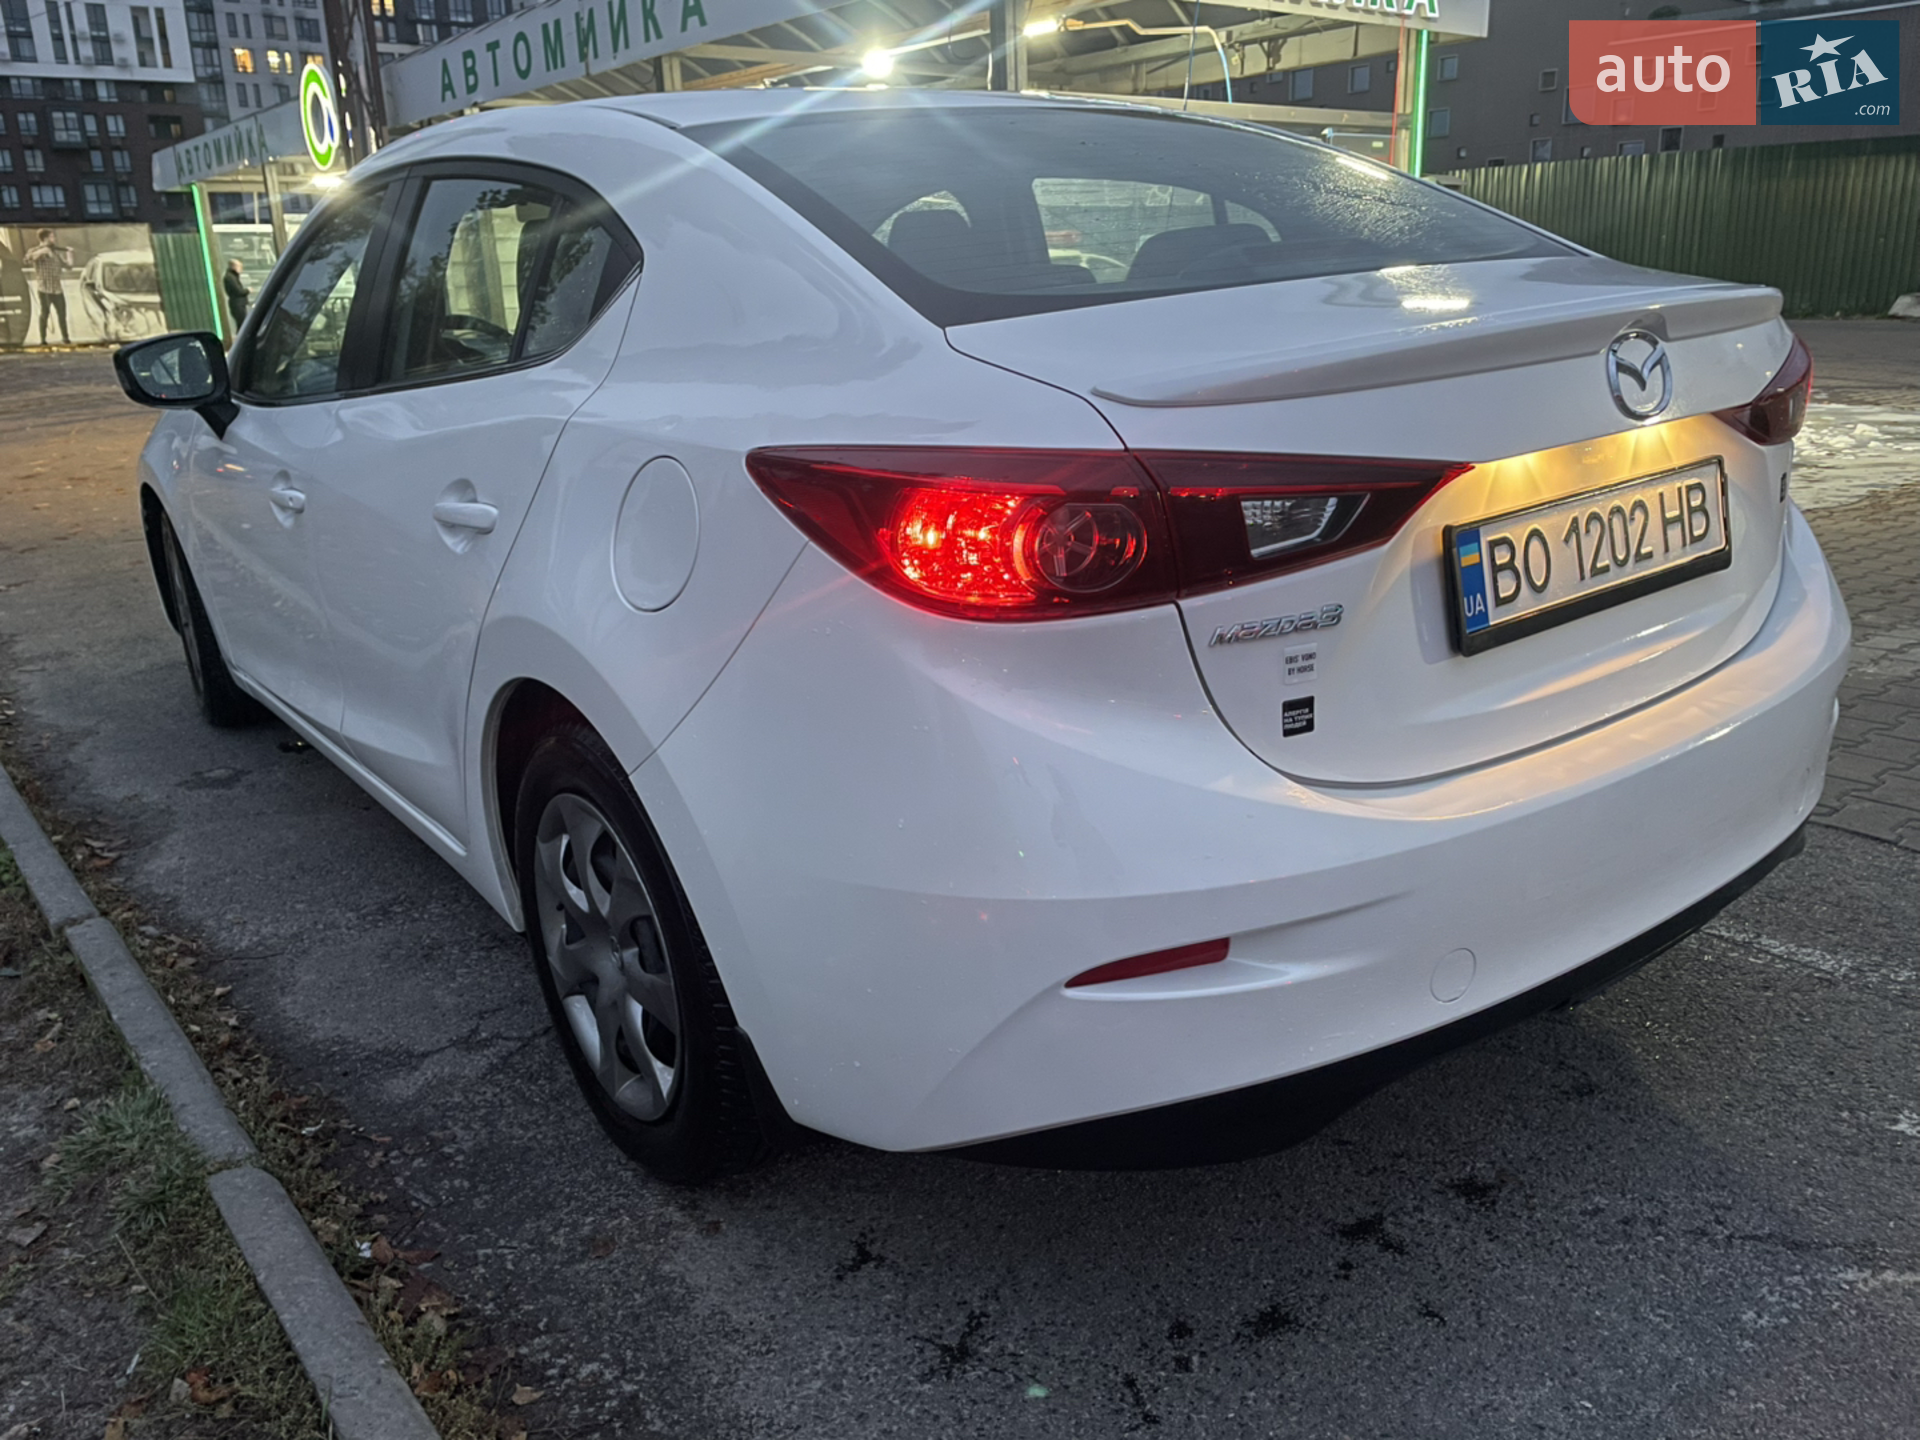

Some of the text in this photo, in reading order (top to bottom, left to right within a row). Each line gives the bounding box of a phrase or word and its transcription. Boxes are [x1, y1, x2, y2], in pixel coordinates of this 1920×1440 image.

[175, 122, 269, 180] АВТОМИЙКА
[1562, 497, 1654, 581] 1202
[1464, 593, 1485, 617] UA
